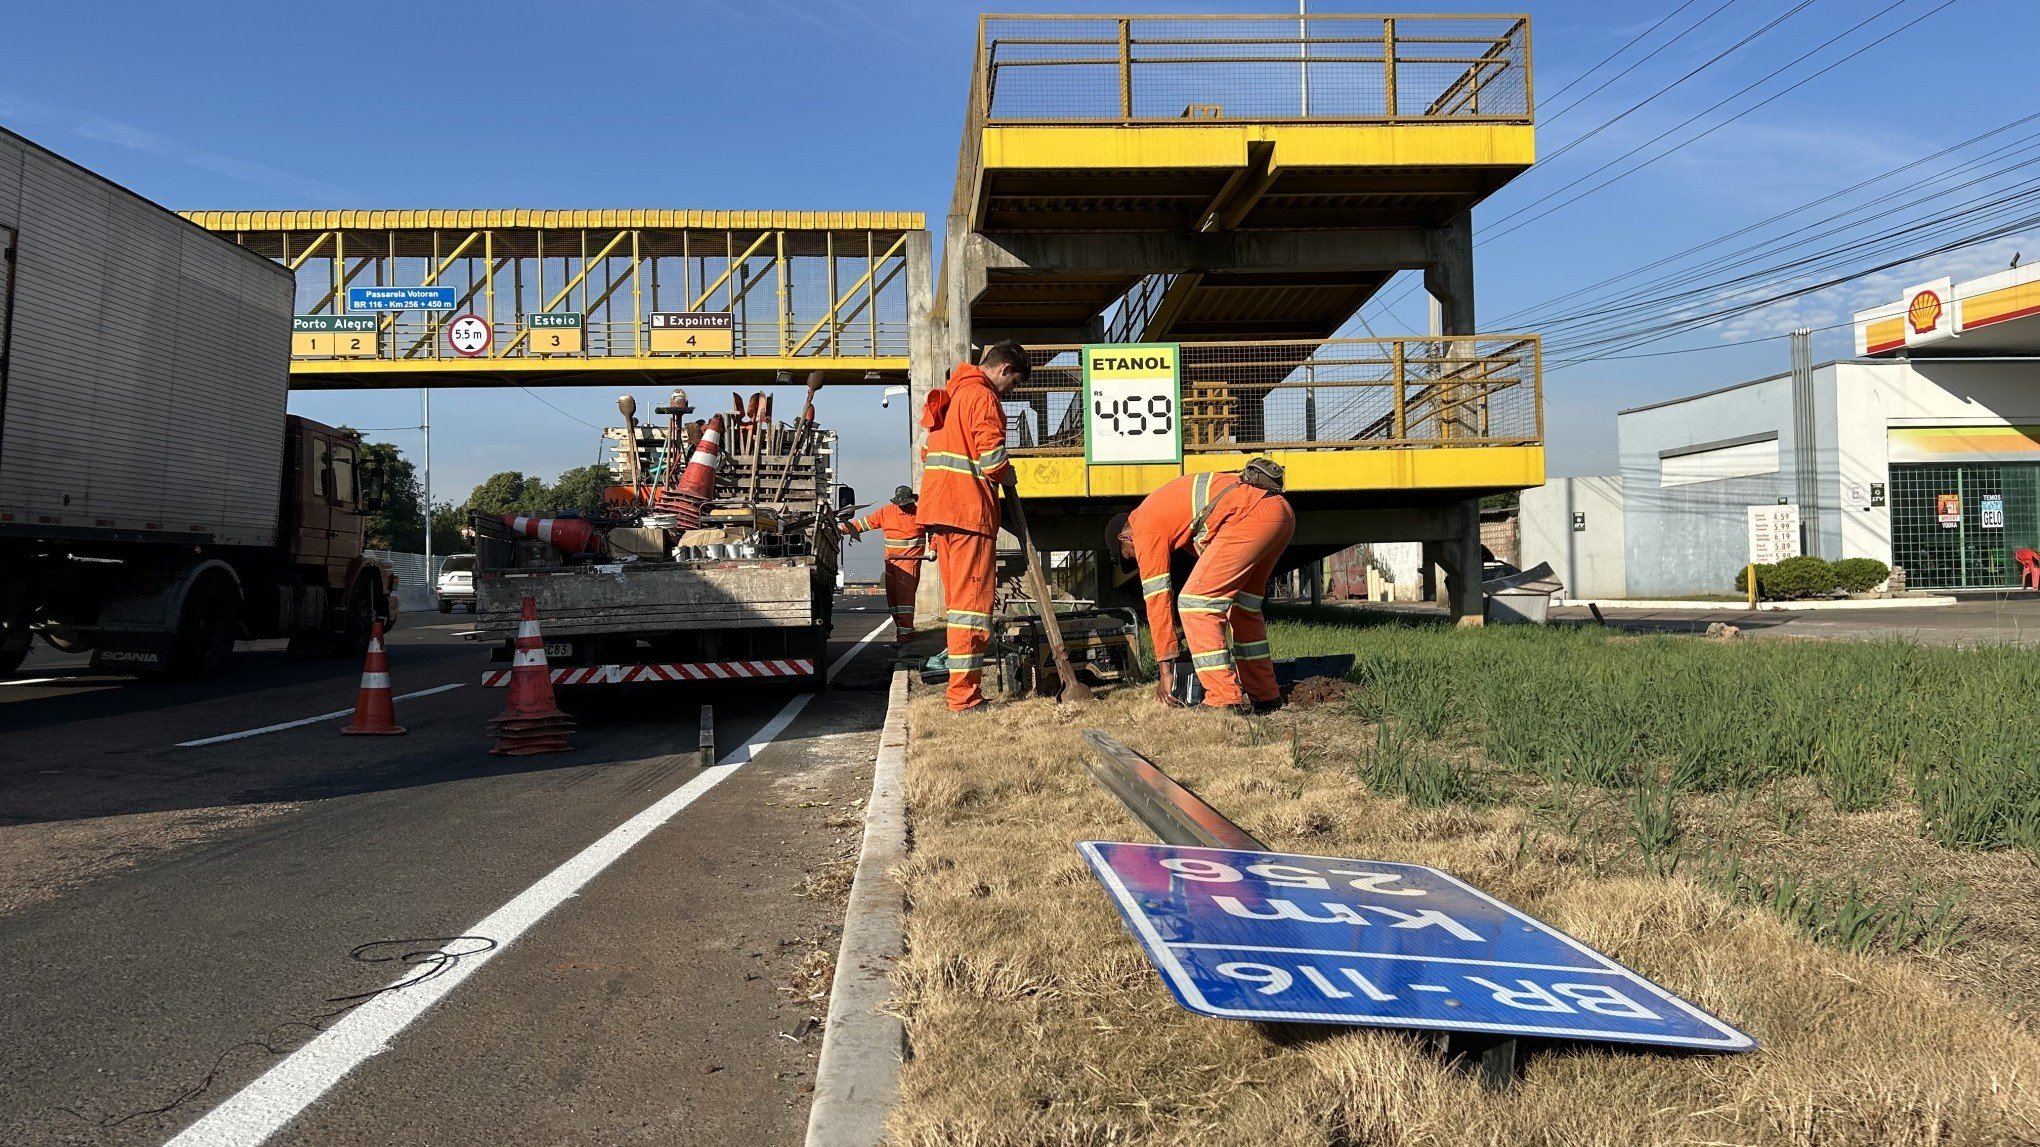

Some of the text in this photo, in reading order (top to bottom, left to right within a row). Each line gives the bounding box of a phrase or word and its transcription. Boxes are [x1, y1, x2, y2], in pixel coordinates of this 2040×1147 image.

[294, 319, 374, 331] Porto Alegre
[534, 316, 575, 325] Esteio
[670, 316, 729, 327] Expointer
[311, 339, 316, 350] 1
[351, 339, 361, 350] 2
[551, 335, 560, 347] 3
[686, 335, 696, 346] 4
[1093, 357, 1171, 371] ETANOL
[1095, 395, 1172, 437] 4,59
[1983, 511, 2002, 526] GELO
[101, 651, 159, 662] SCANIA
[1159, 858, 1427, 896] 256
